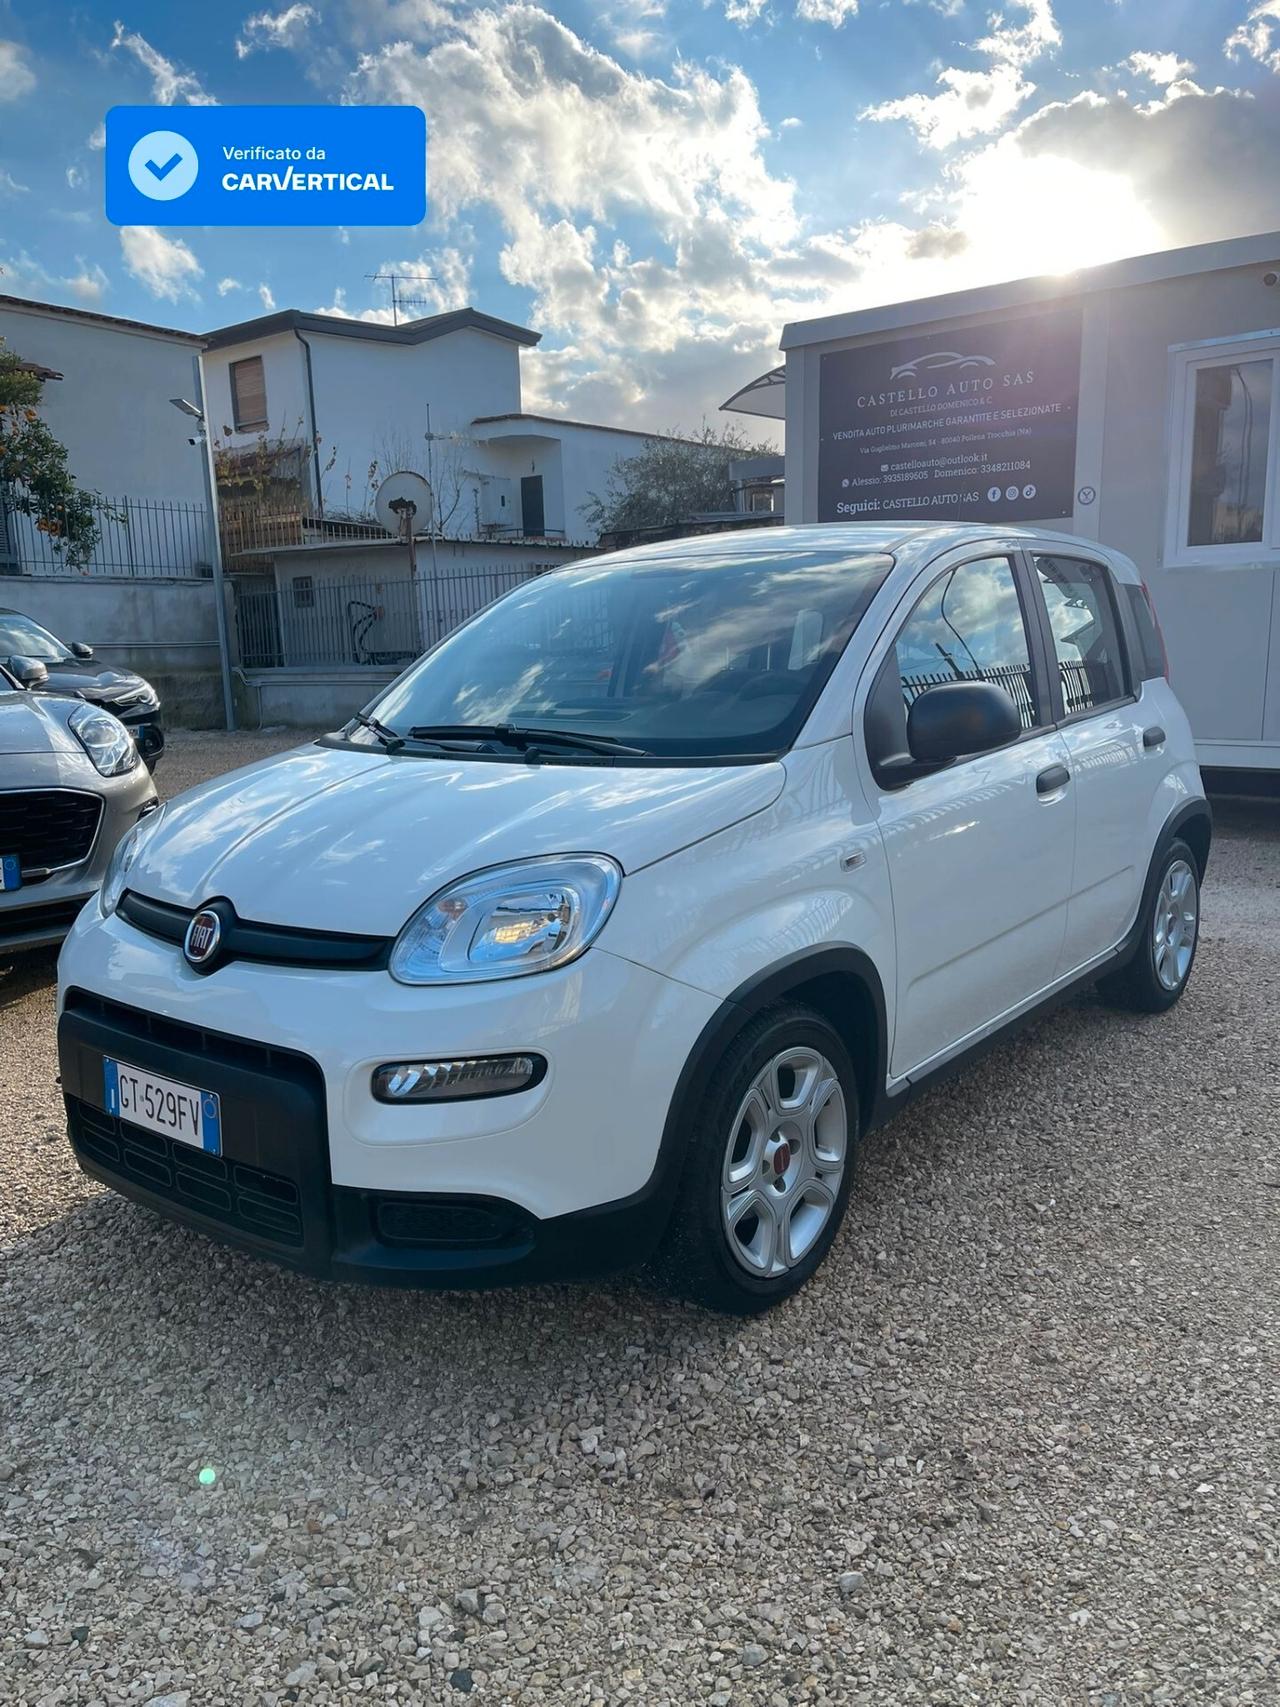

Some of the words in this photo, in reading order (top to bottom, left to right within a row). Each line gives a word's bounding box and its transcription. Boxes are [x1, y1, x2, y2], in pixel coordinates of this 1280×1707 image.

[857, 386, 938, 408] CASTELLO
[946, 378, 993, 396] AUTO
[1003, 370, 1034, 387] SAS
[890, 409, 898, 417] DI
[899, 404, 936, 416] CASTELLO
[937, 398, 979, 411] DOMENICO
[832, 428, 864, 441] VENDITA
[865, 425, 886, 437] AUTO
[887, 418, 945, 434] PLURIMARCHE
[945, 411, 992, 426] GARANTITE
[993, 411, 999, 420] E
[1000, 403, 1062, 420] SELEZIONATE
[870, 443, 900, 454] Guglielmo
[961, 433, 986, 443] Pollena
[987, 429, 1016, 440] Trocchia
[852, 477, 881, 487] Alessio:
[883, 470, 929, 484] 3935189605
[980, 460, 1031, 474] 3348211084
[890, 453, 988, 471] castelloauto@outlook.it
[836, 498, 880, 515] Seguici:
[882, 495, 930, 510] CASTELLO
[931, 493, 959, 506] AUTO
[190, 924, 213, 949] FIAT
